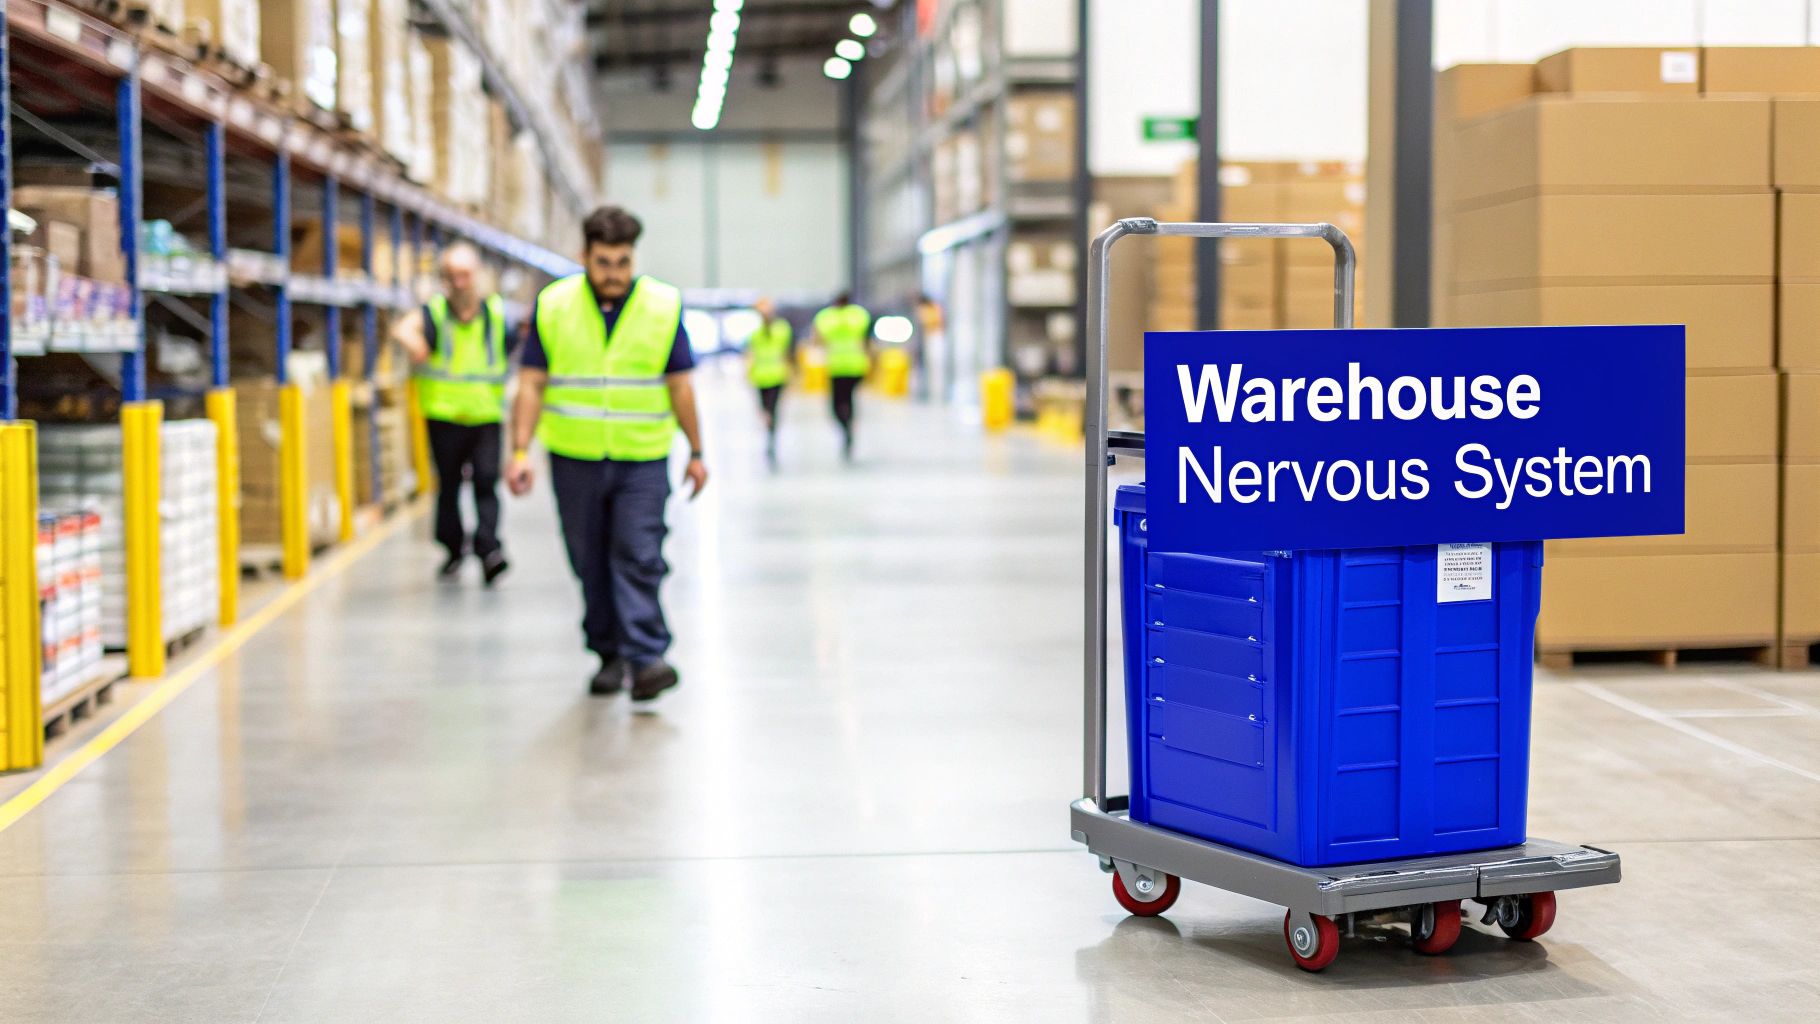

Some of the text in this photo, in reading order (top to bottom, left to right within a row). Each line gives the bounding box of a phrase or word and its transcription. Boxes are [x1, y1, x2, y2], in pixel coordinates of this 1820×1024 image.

[1177, 363, 1541, 423] Warehouse
[1178, 444, 1651, 510] Nervous System
